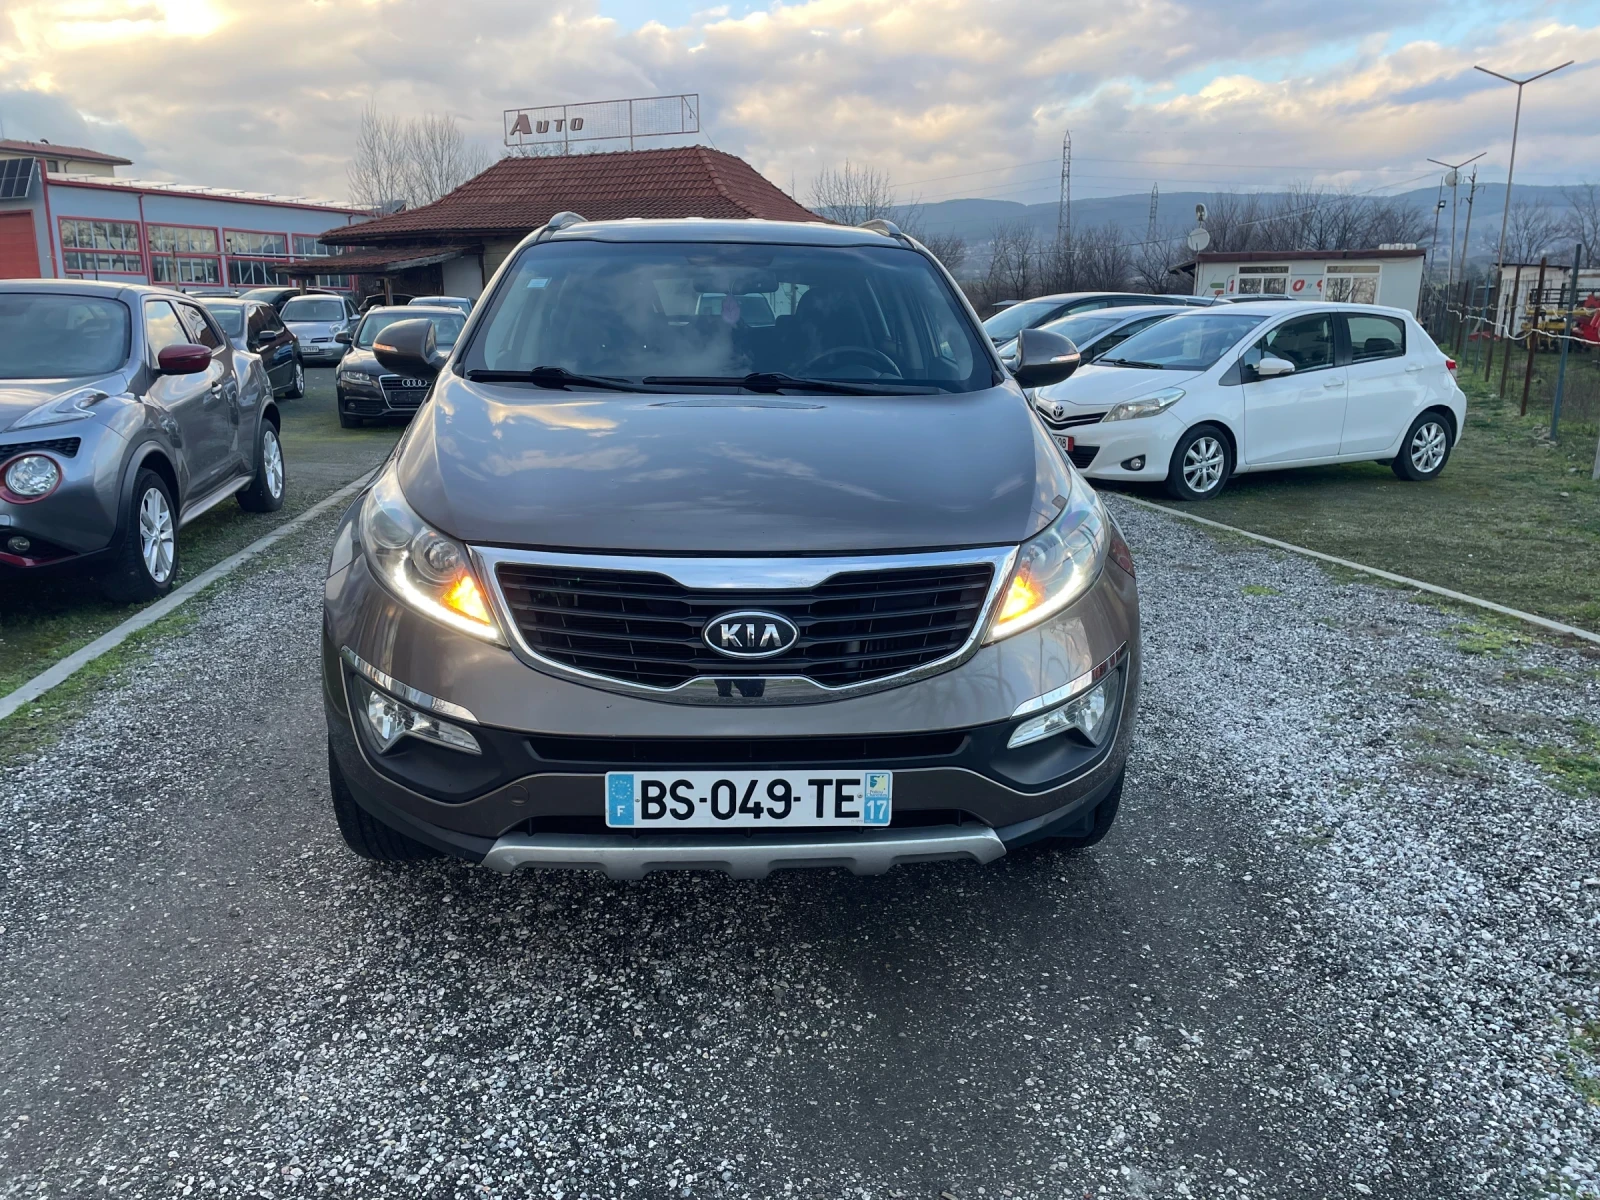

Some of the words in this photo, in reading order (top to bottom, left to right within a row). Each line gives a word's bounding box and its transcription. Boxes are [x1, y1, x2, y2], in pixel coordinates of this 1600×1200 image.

[720, 623, 783, 648] KIA
[616, 805, 626, 817] F
[867, 800, 888, 820] 17
